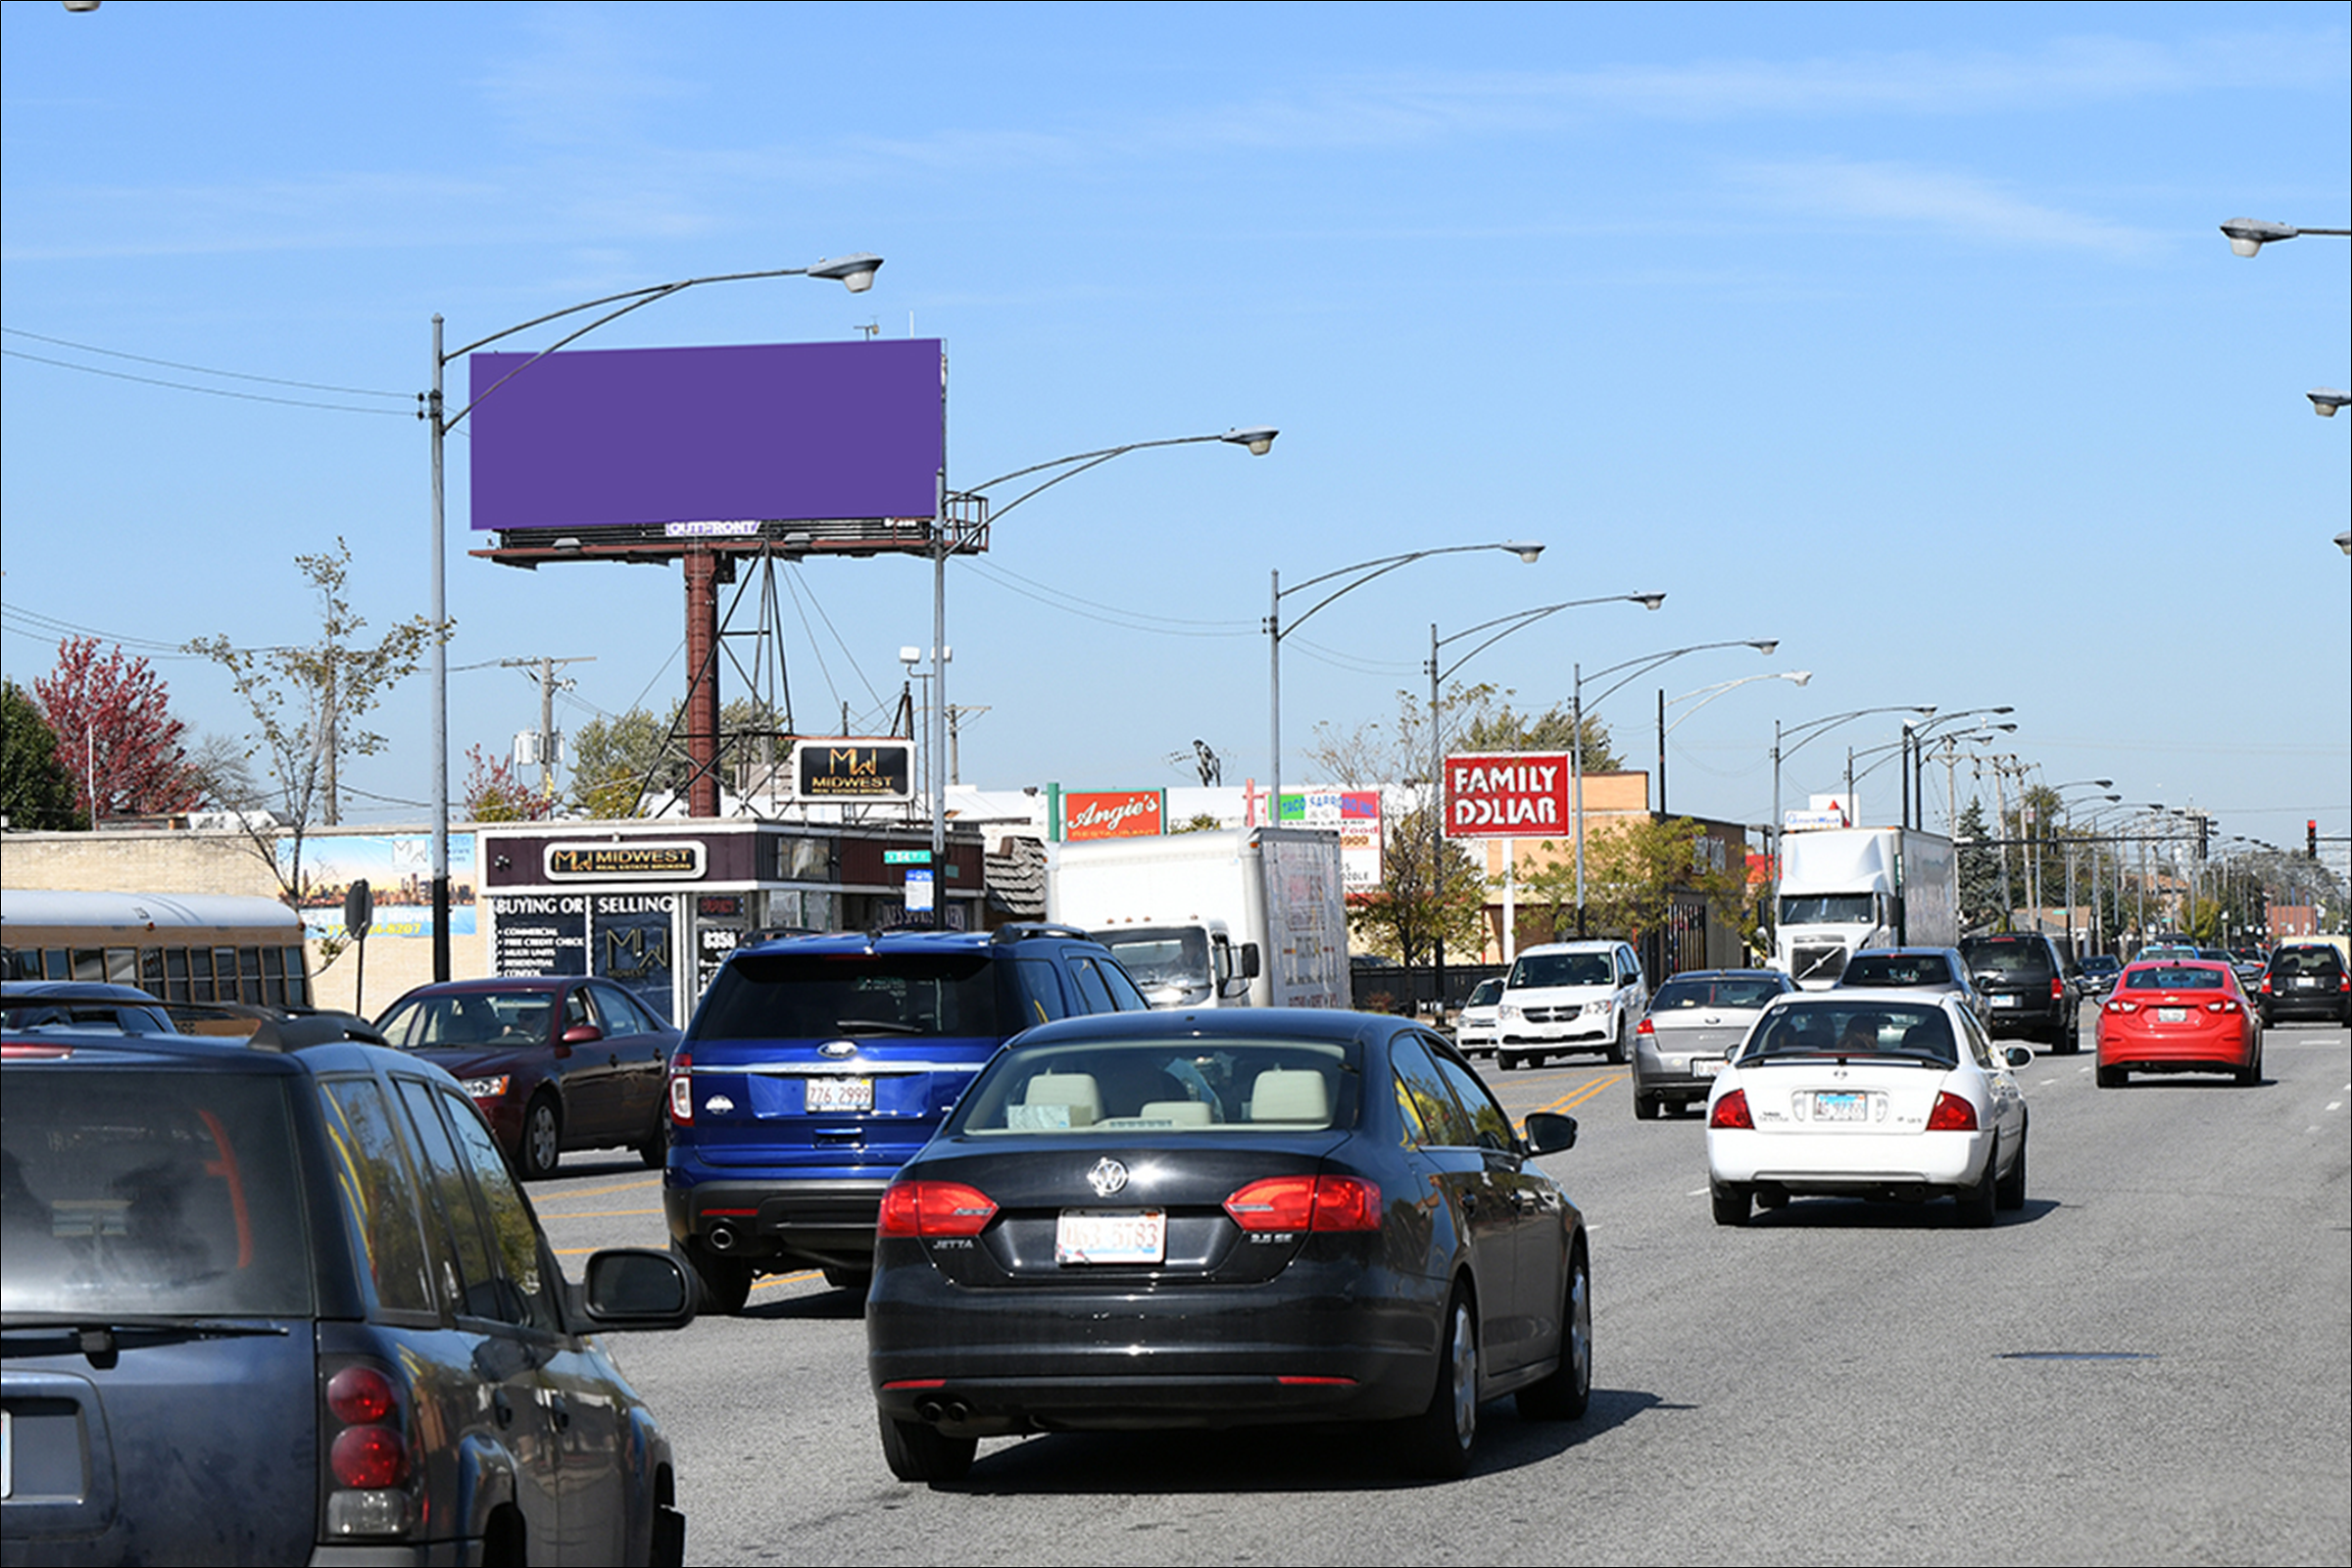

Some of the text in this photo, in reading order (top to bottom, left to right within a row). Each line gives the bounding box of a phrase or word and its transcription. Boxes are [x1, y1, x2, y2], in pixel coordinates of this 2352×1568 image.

[811, 776, 893, 788] MIDWEST
[1454, 765, 1558, 793] FAMILY
[1067, 794, 1158, 830] Angie's
[1455, 797, 1557, 825] DOLLAR
[596, 849, 691, 863] MIDWEST
[496, 897, 675, 914] BUYING OR SELLING
[504, 938, 522, 947] FREE
[531, 948, 556, 956] UNITS
[933, 1239, 973, 1250] JETTA
